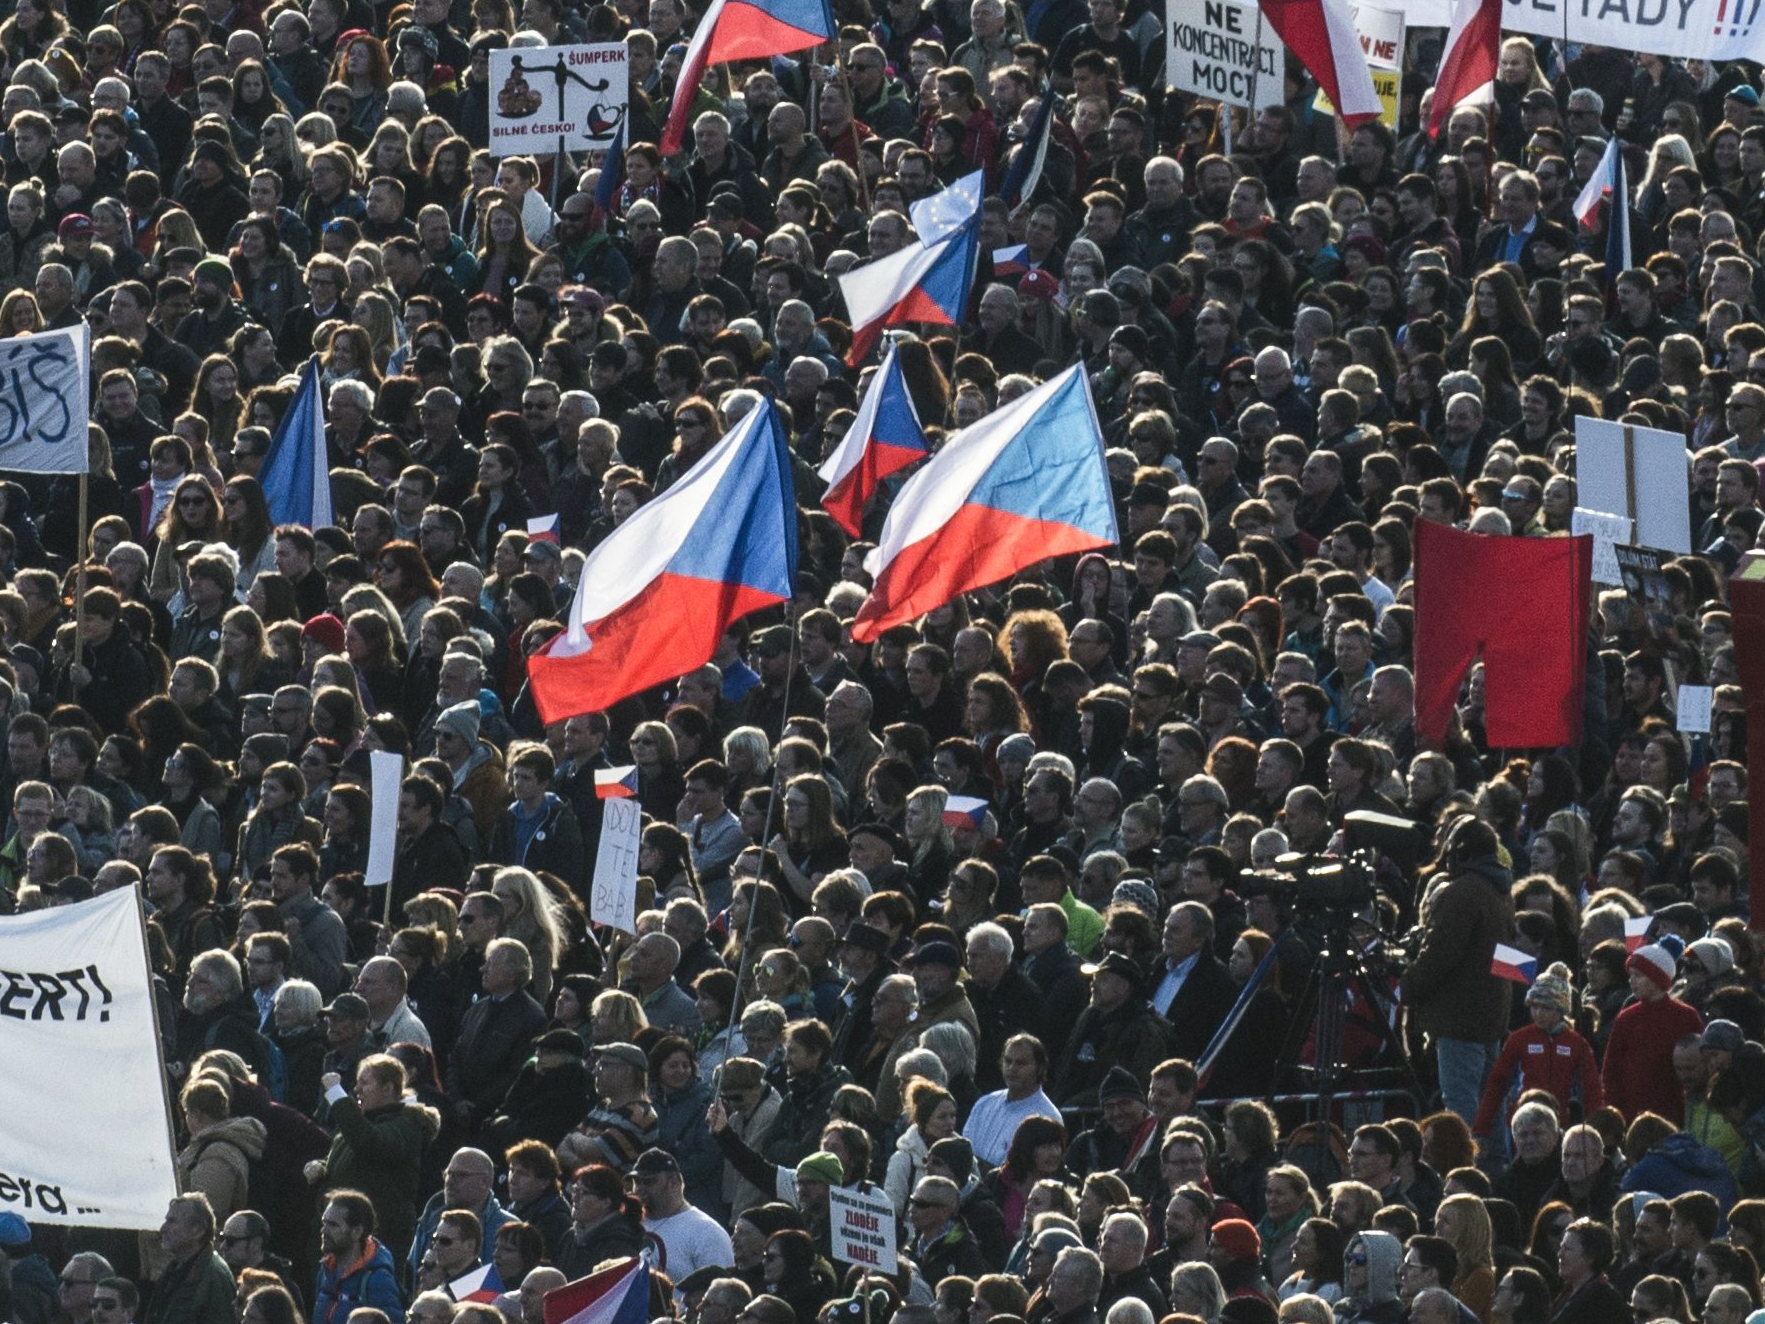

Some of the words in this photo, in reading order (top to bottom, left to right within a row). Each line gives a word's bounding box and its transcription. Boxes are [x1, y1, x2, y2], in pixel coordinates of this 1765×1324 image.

[1204, 1, 1243, 34] NE
[568, 48, 627, 67] ŠUMPERK
[1172, 19, 1276, 75] KONCENTRACI
[492, 123, 528, 138] SILNÉ
[532, 120, 576, 137] ČESKO!
[845, 1209, 880, 1233] ZLODĚJE
